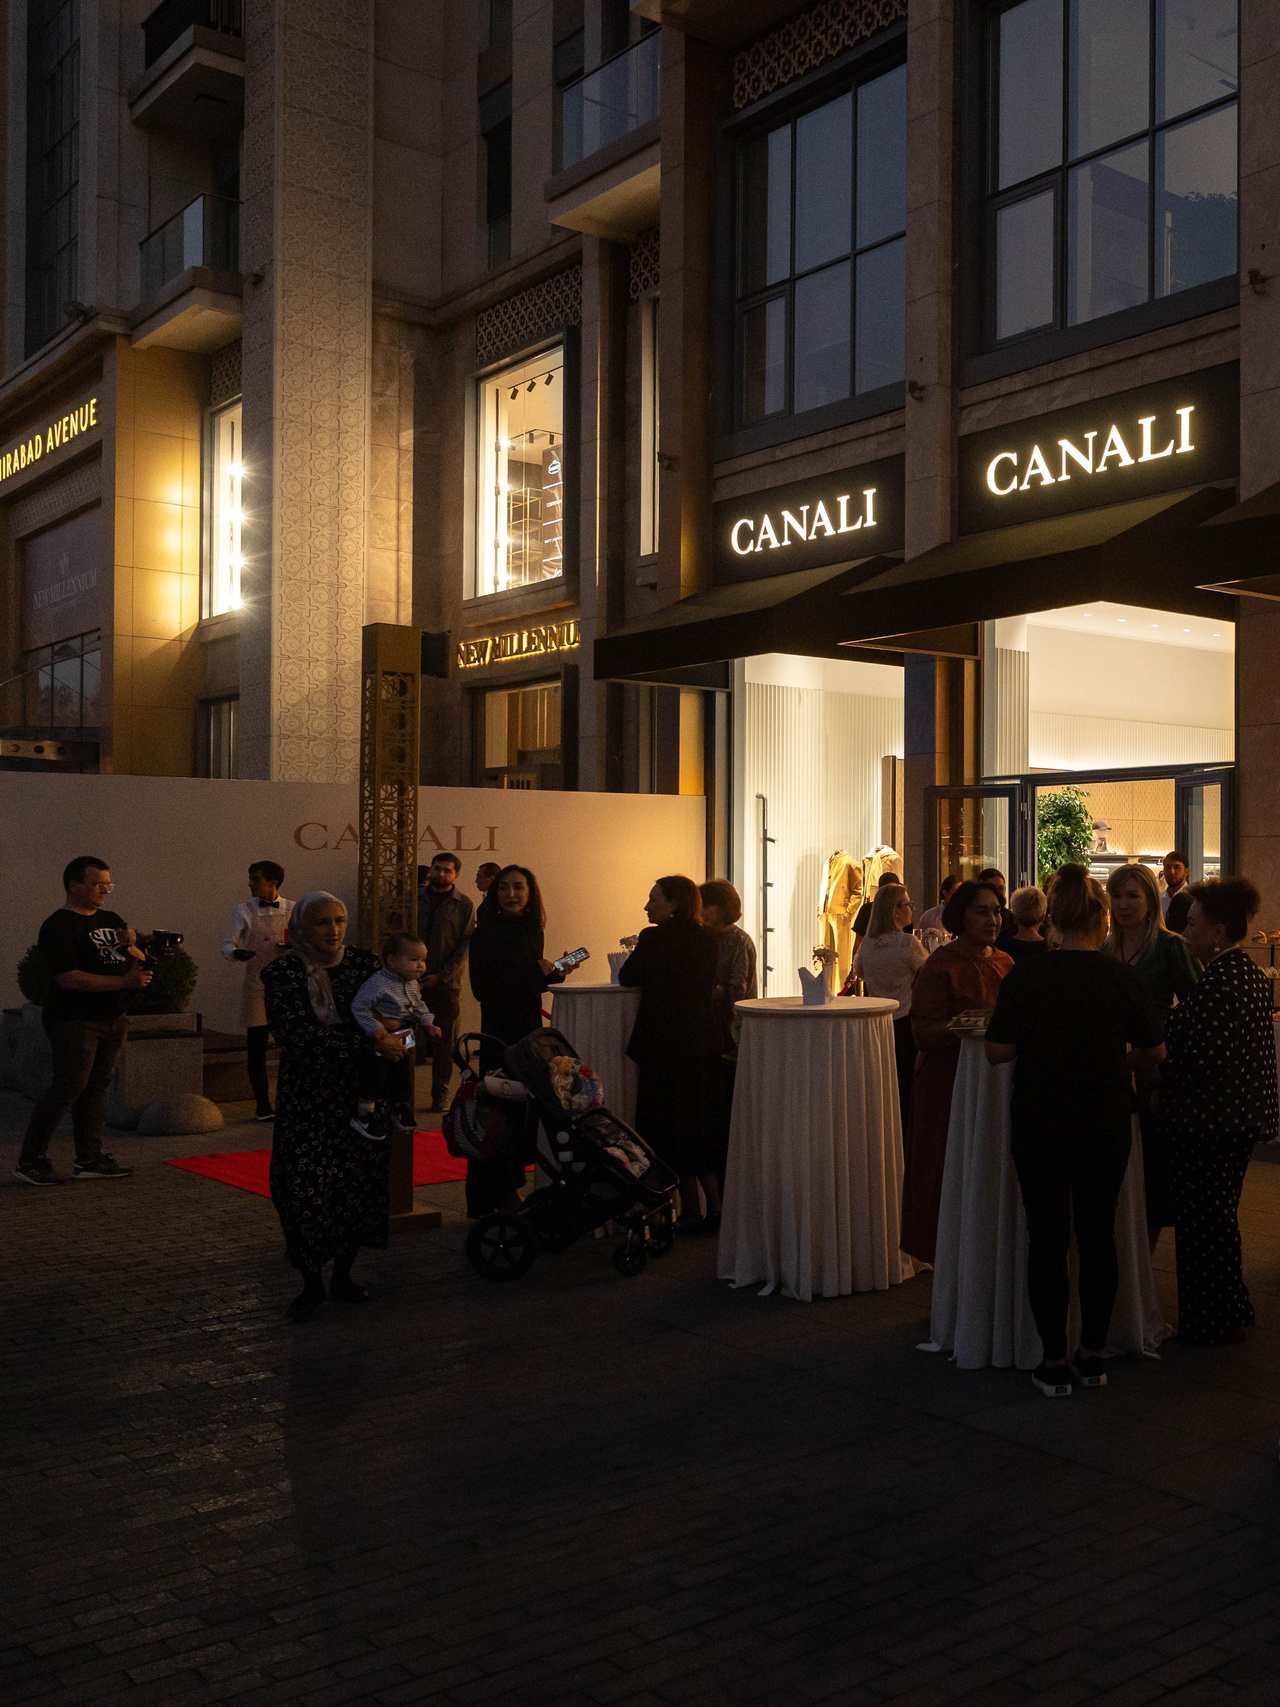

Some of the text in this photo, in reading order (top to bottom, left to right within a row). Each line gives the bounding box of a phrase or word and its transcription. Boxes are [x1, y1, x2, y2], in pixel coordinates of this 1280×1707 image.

[0, 398, 98, 482] IRABAD AVENUE
[984, 404, 1196, 496] CANALI
[729, 487, 878, 555] CANALI
[456, 638, 492, 669] NEW
[293, 822, 500, 852] CAALI
